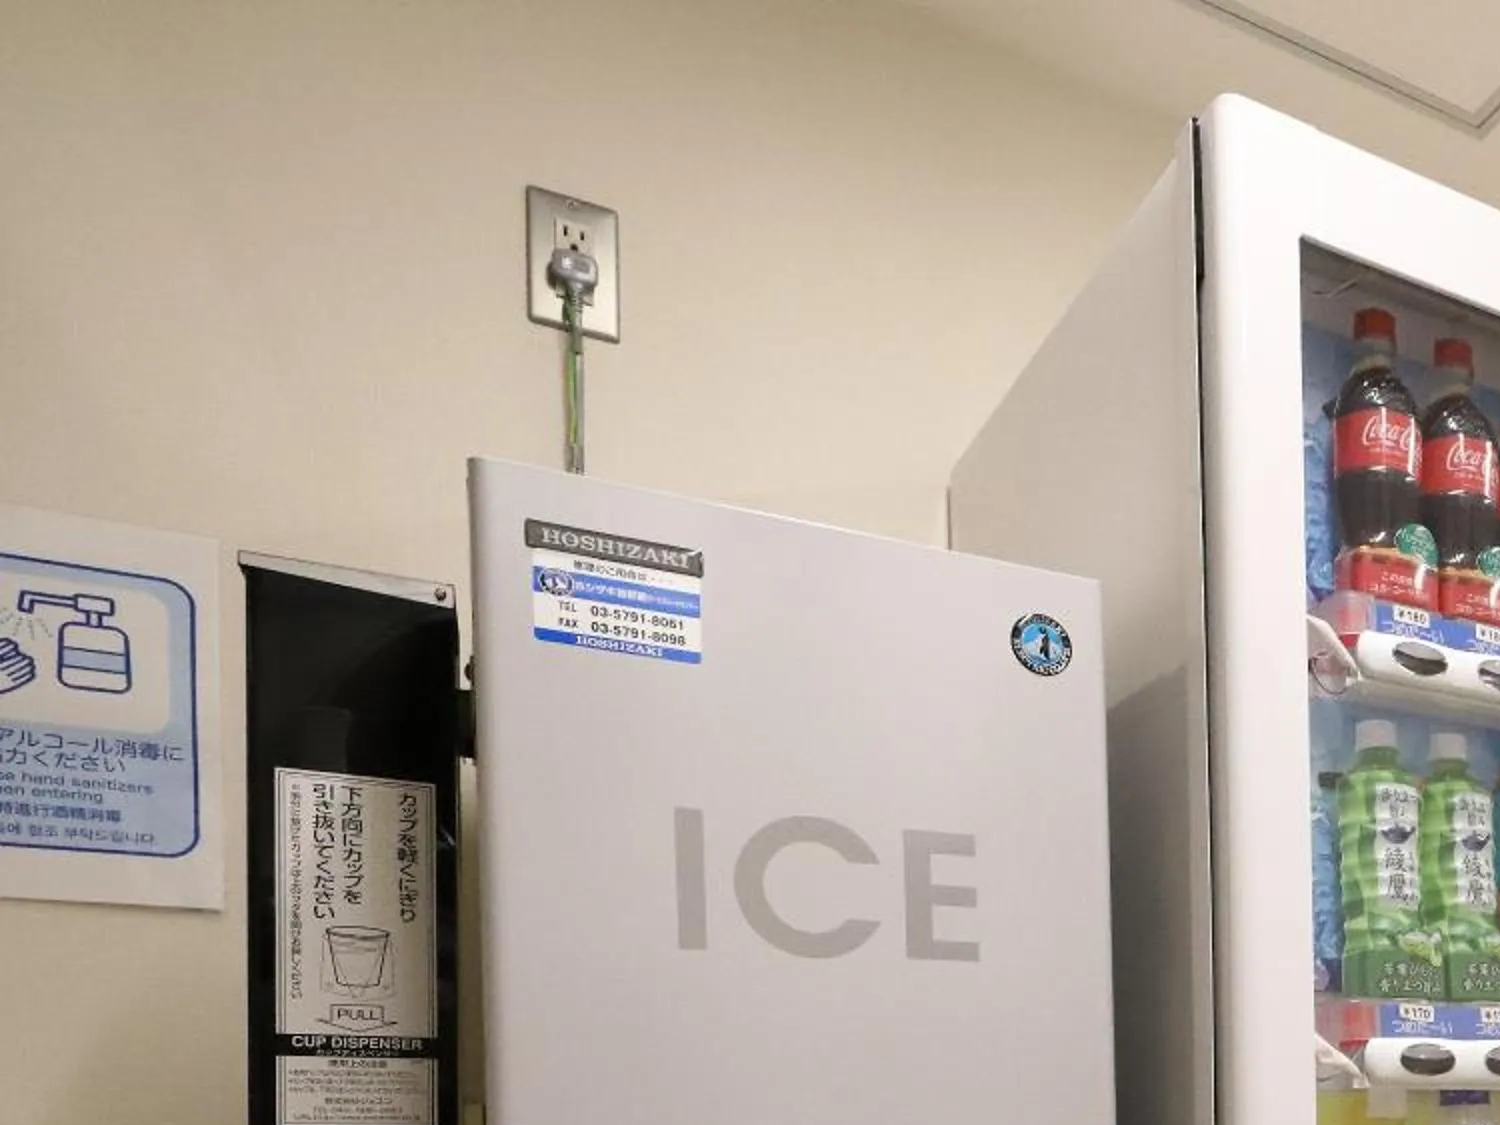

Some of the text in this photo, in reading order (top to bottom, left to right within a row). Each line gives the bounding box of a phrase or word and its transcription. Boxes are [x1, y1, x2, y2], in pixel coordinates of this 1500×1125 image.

[542, 527, 690, 569] HOSHIZAKI
[559, 601, 577, 613] TEL
[559, 617, 579, 628] FAX
[575, 635, 663, 657] HOSHIZAKI
[0, 748, 126, 772] 力ください
[22, 771, 64, 786] hand
[71, 778, 154, 795] sanitizers
[32, 788, 104, 804] entering
[312, 783, 336, 920] 引き抜いてください
[341, 785, 364, 905] 下方向にカップを
[674, 806, 981, 962] ICE
[337, 1008, 379, 1021] PULL
[291, 1035, 423, 1051] CUP DISPENSER
